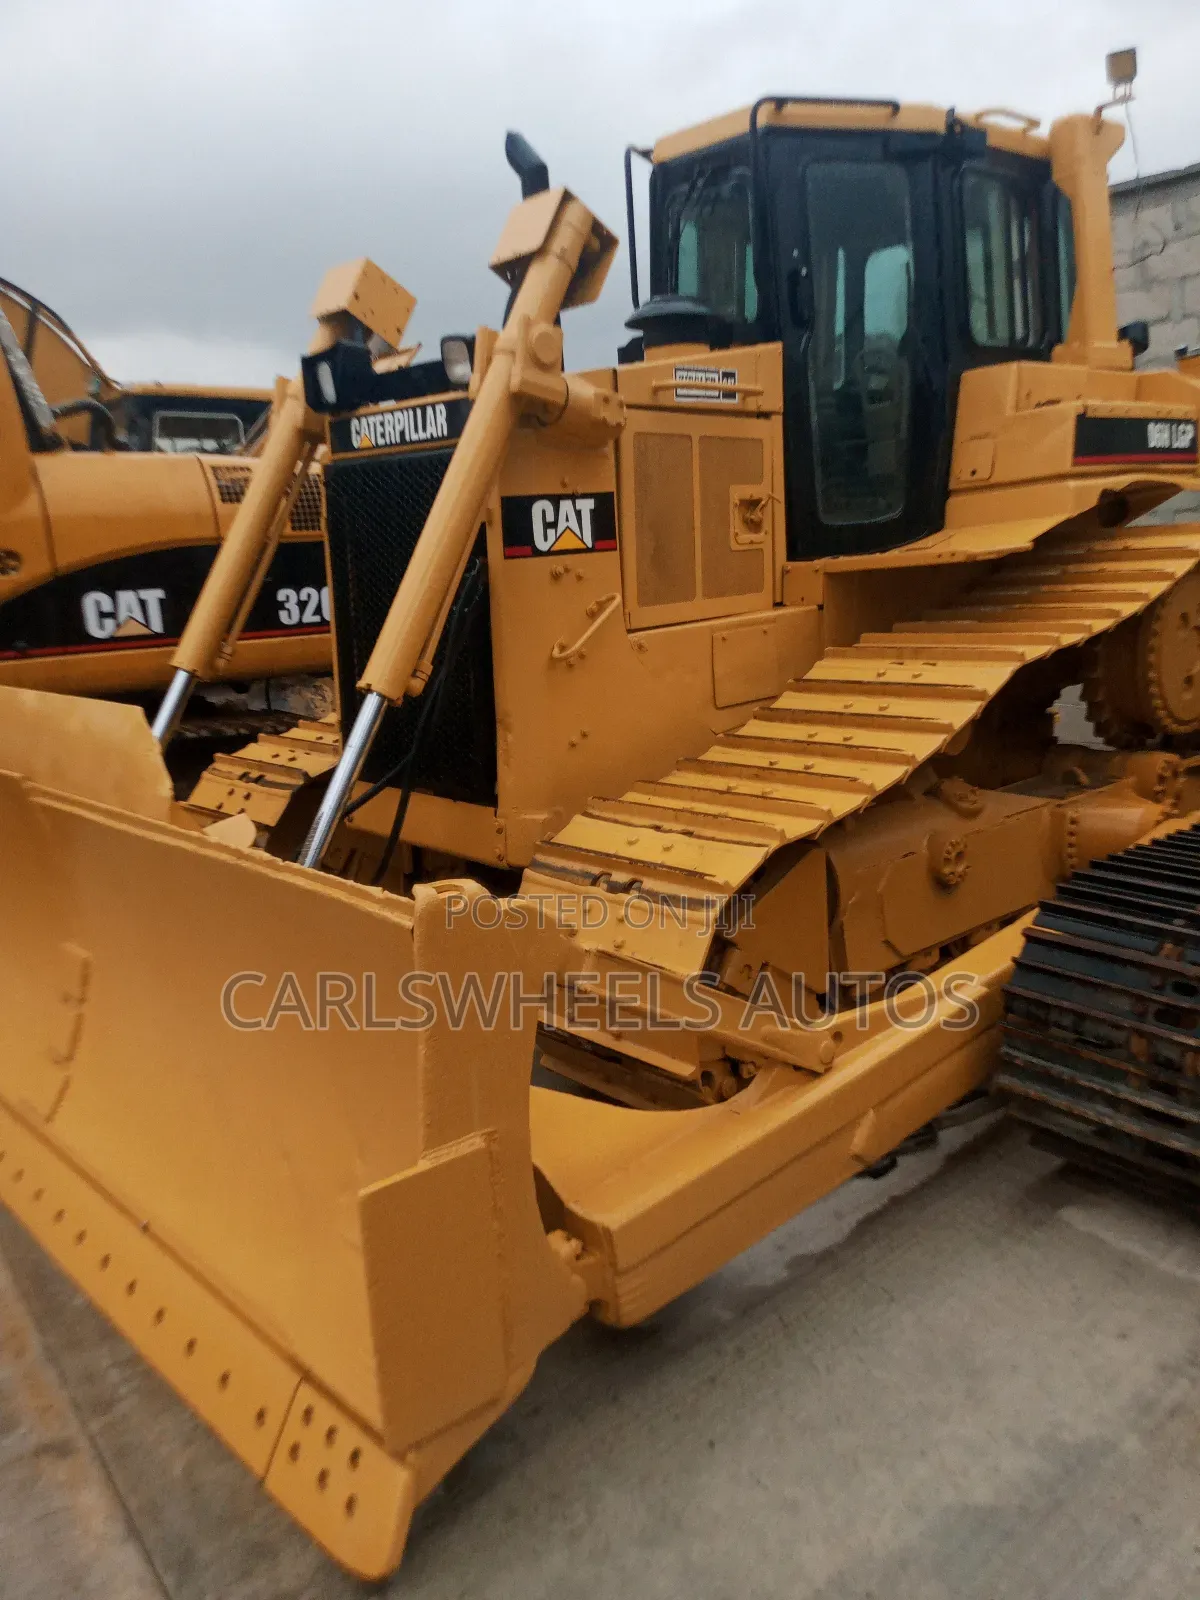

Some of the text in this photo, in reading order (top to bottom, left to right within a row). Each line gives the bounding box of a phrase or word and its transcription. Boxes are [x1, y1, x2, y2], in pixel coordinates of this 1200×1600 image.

[350, 403, 448, 449] CATERPILLAR
[531, 498, 595, 552] CAT
[81, 588, 166, 639] CAT
